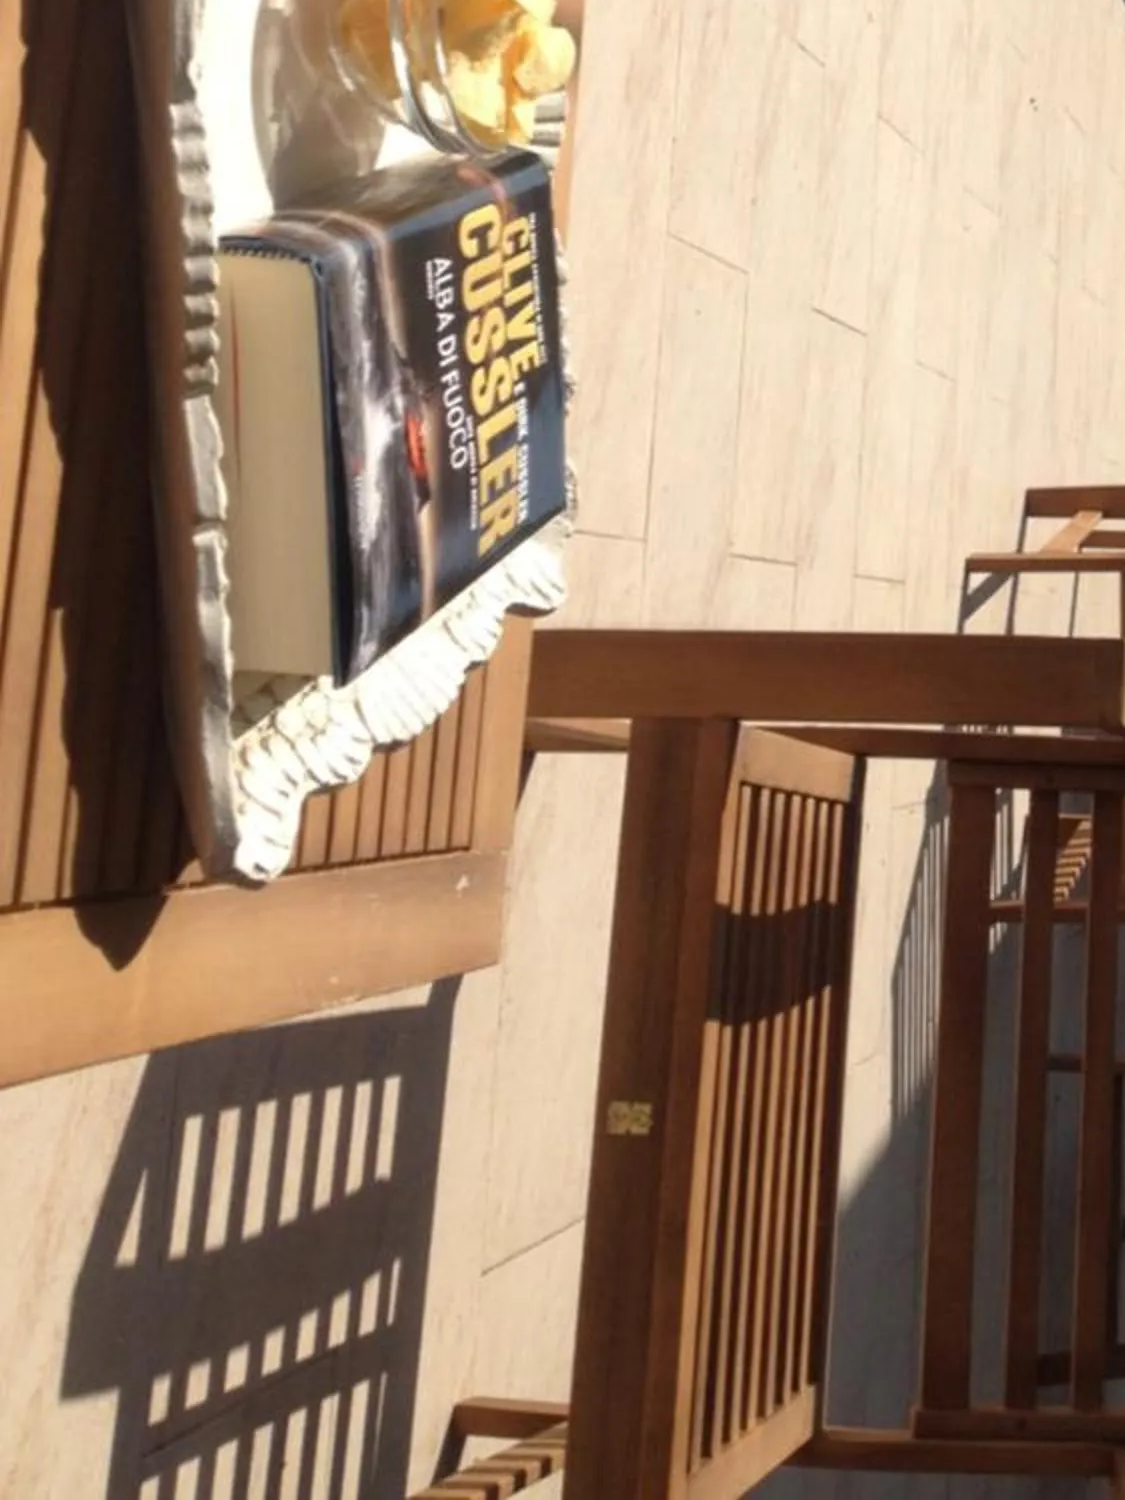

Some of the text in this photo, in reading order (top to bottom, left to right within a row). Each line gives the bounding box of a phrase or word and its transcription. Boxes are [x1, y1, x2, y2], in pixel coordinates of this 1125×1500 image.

[432, 257, 468, 469] ALBA DI FUOCO
[459, 204, 519, 558] CUSSLER
[502, 216, 539, 380] CLIVE
